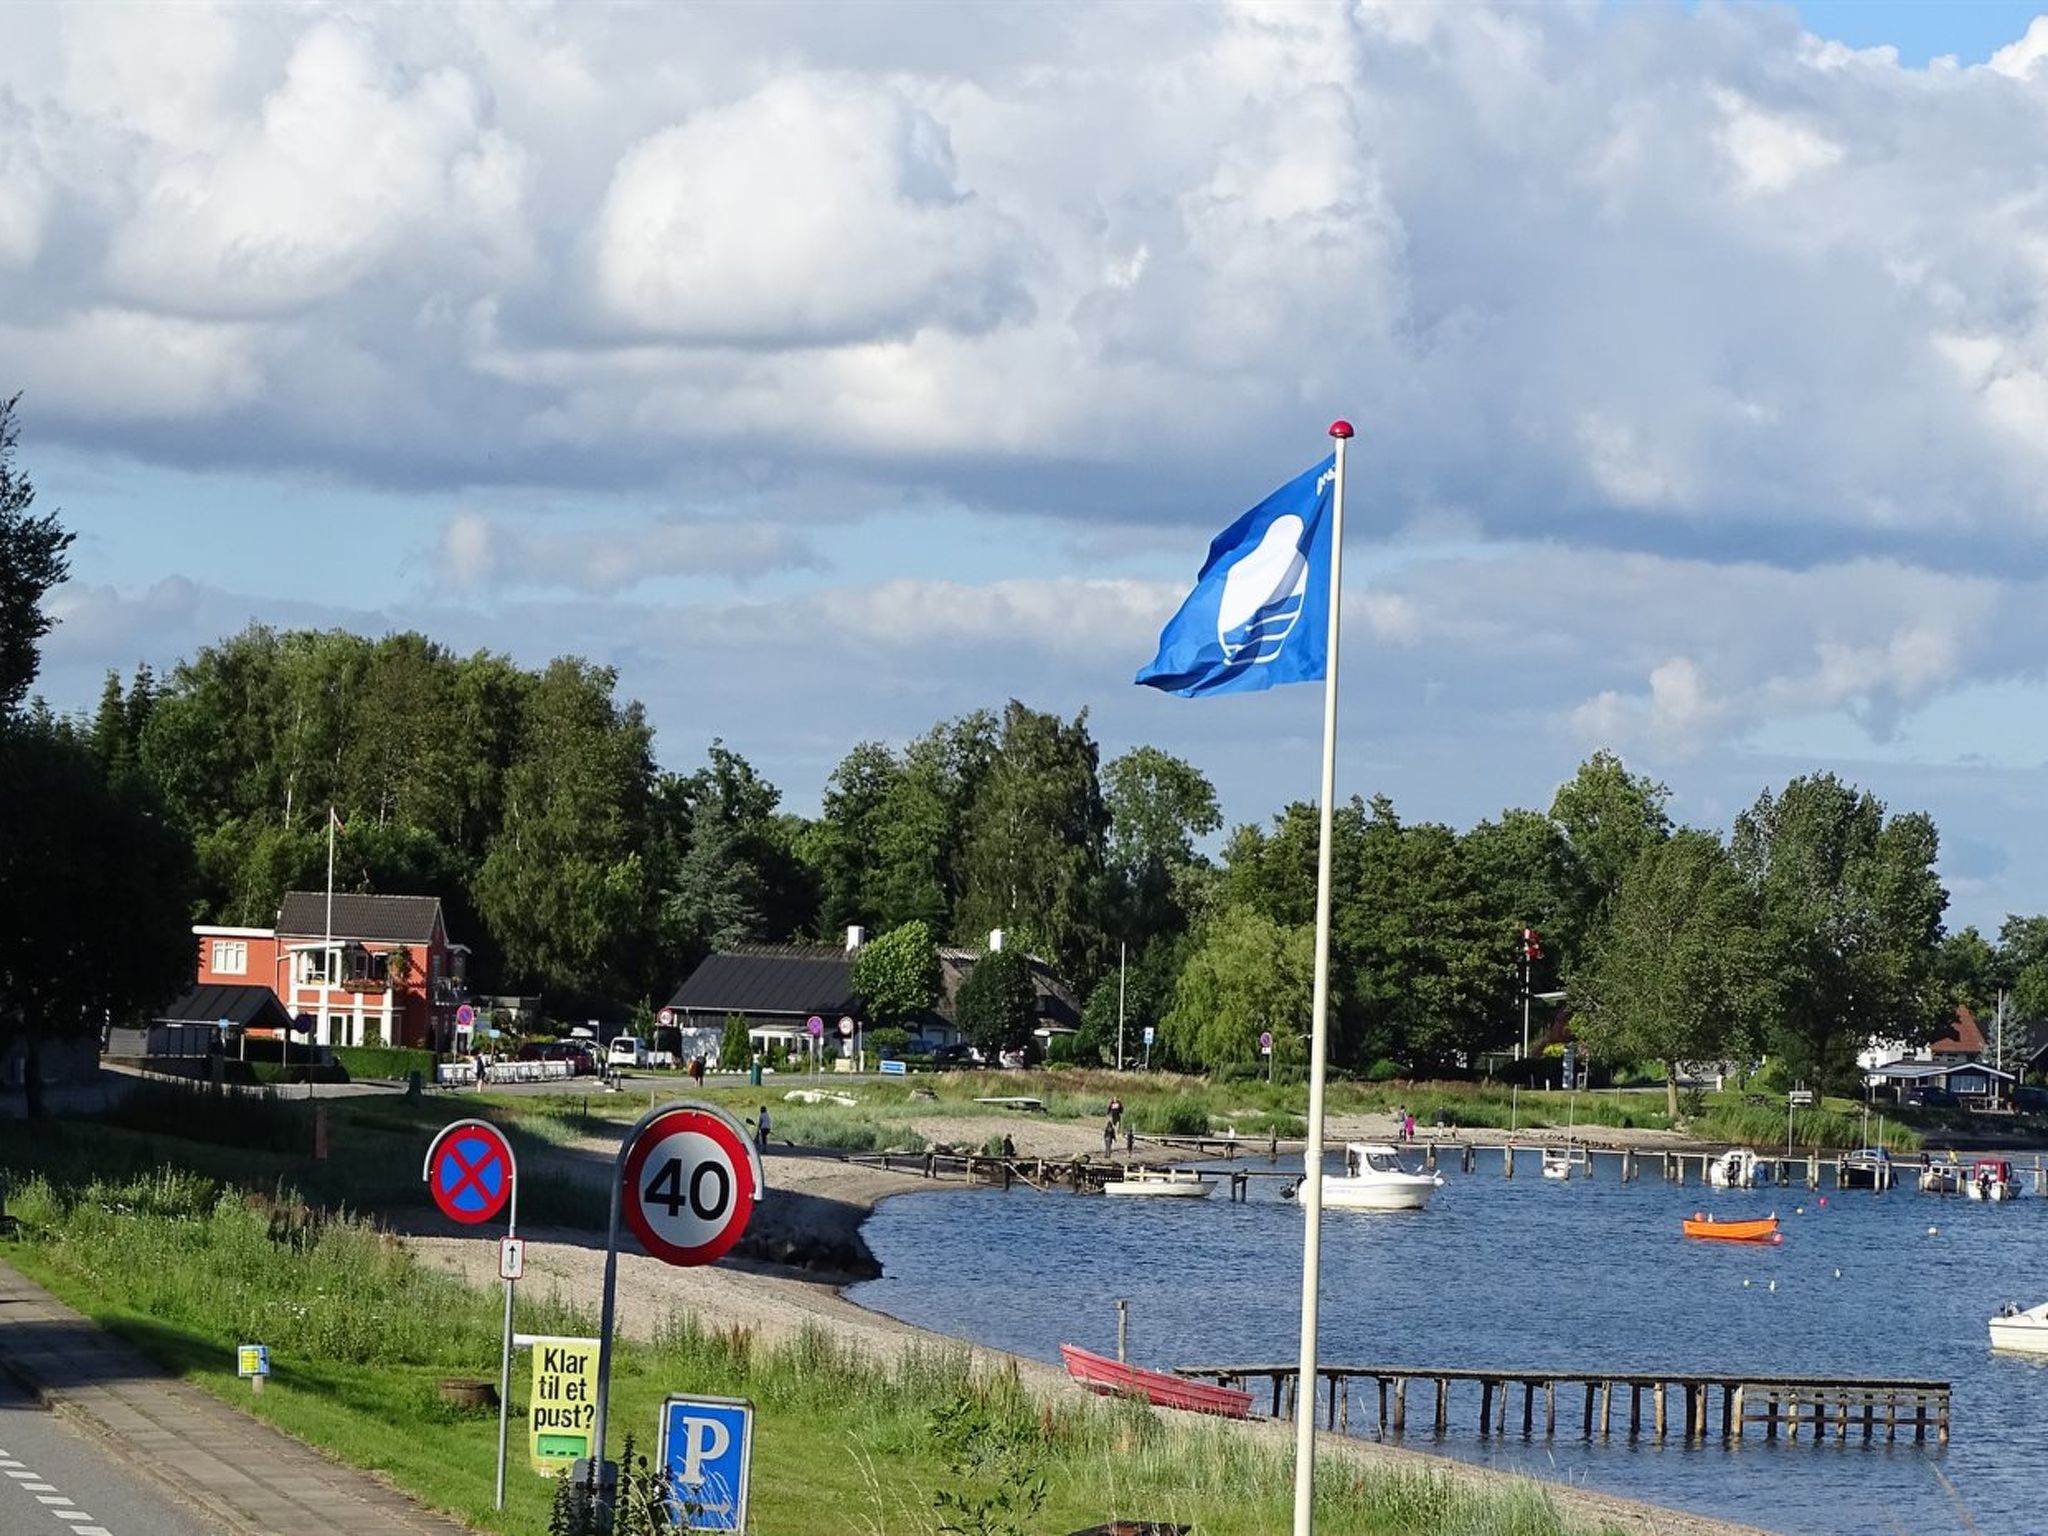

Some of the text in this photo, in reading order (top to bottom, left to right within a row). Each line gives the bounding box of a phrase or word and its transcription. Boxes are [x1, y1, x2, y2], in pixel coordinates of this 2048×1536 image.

[645, 1158, 729, 1221] 40
[544, 1348, 588, 1374] Klar
[538, 1376, 587, 1401] til et
[534, 1404, 594, 1431] pust?
[679, 1417, 730, 1485] P
